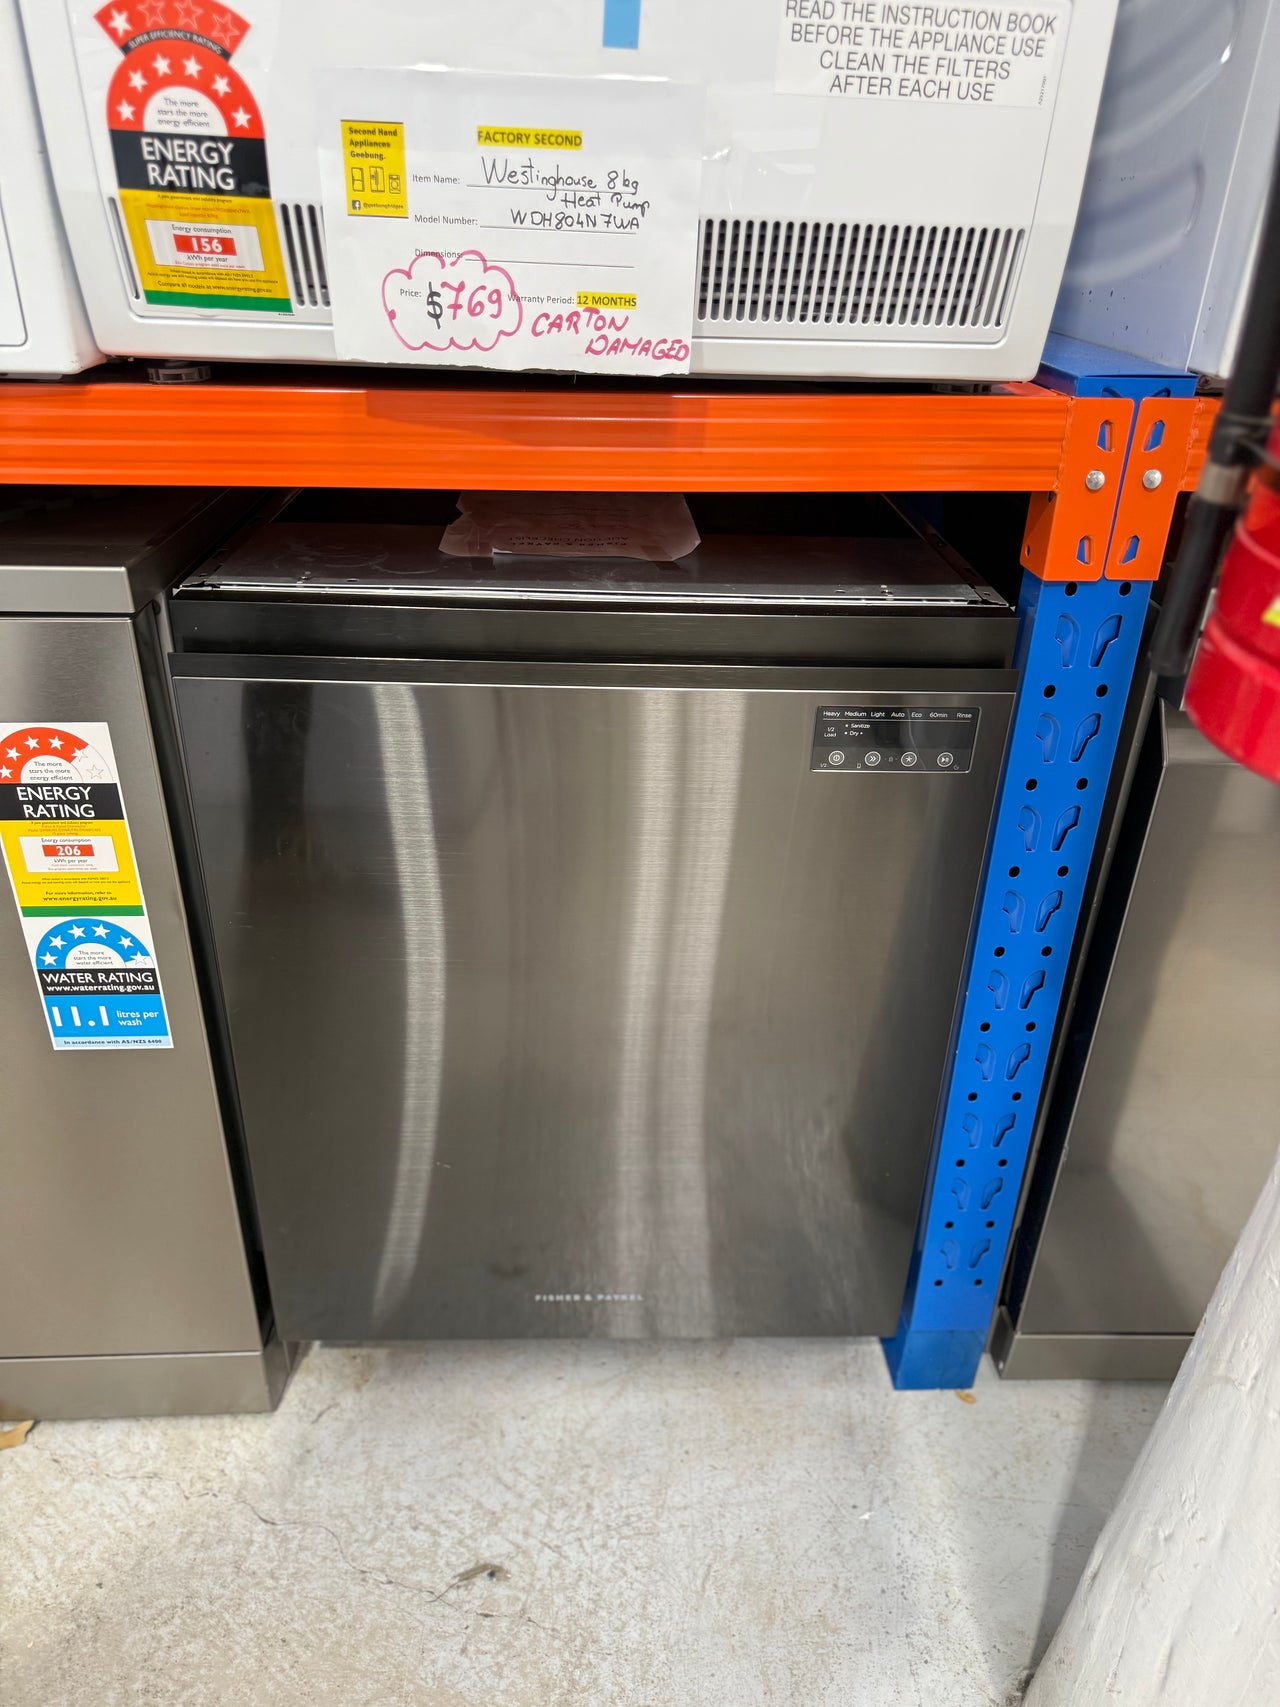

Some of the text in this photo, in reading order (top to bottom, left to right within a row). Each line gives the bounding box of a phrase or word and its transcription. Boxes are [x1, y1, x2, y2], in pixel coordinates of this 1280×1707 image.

[785, 0, 1057, 35] READ THE INSTRUCTION BOOK
[128, 29, 222, 54] SUPER EFFICIENCY RATING
[791, 23, 1046, 58] BEFORE THE APPLIANCE USE
[820, 50, 1011, 80] CLEAN THE FILTERS
[829, 74, 996, 102] AFTER EACH USE
[164, 97, 199, 108] The more
[176, 109, 188, 117] the
[158, 119, 210, 128] energy efficient
[348, 127, 398, 137] Second Hand
[477, 130, 583, 147] FACTORY SECOND
[140, 136, 234, 165] ENERGY
[349, 139, 391, 148] Appliances
[350, 151, 386, 162] Geebung.
[147, 163, 236, 190] RATING
[412, 174, 432, 183] Item
[433, 175, 461, 184] Name:
[481, 156, 598, 201] Westinghouse
[560, 192, 650, 217] Heat Pump
[414, 214, 440, 224] Model
[442, 216, 478, 226] Number:
[171, 224, 232, 234] Energy consumption
[191, 237, 223, 253] 156
[186, 254, 203, 262] kWh
[215, 256, 228, 264] year
[400, 280, 503, 330] Price: $769
[507, 293, 637, 307] Warranty Period: 12 MONTHS
[531, 306, 630, 338] CARTON
[584, 334, 690, 362] DAMAGED
[822, 710, 841, 718] Heavy
[16, 786, 92, 801] ENERGY
[22, 804, 96, 818] RATING
[56, 846, 81, 856] 206
[42, 972, 154, 984] WATER RATING
[46, 984, 155, 992] www.waterrating.gov.au
[51, 1005, 160, 1027] 11.1 litres per
[118, 1018, 142, 1026] wash
